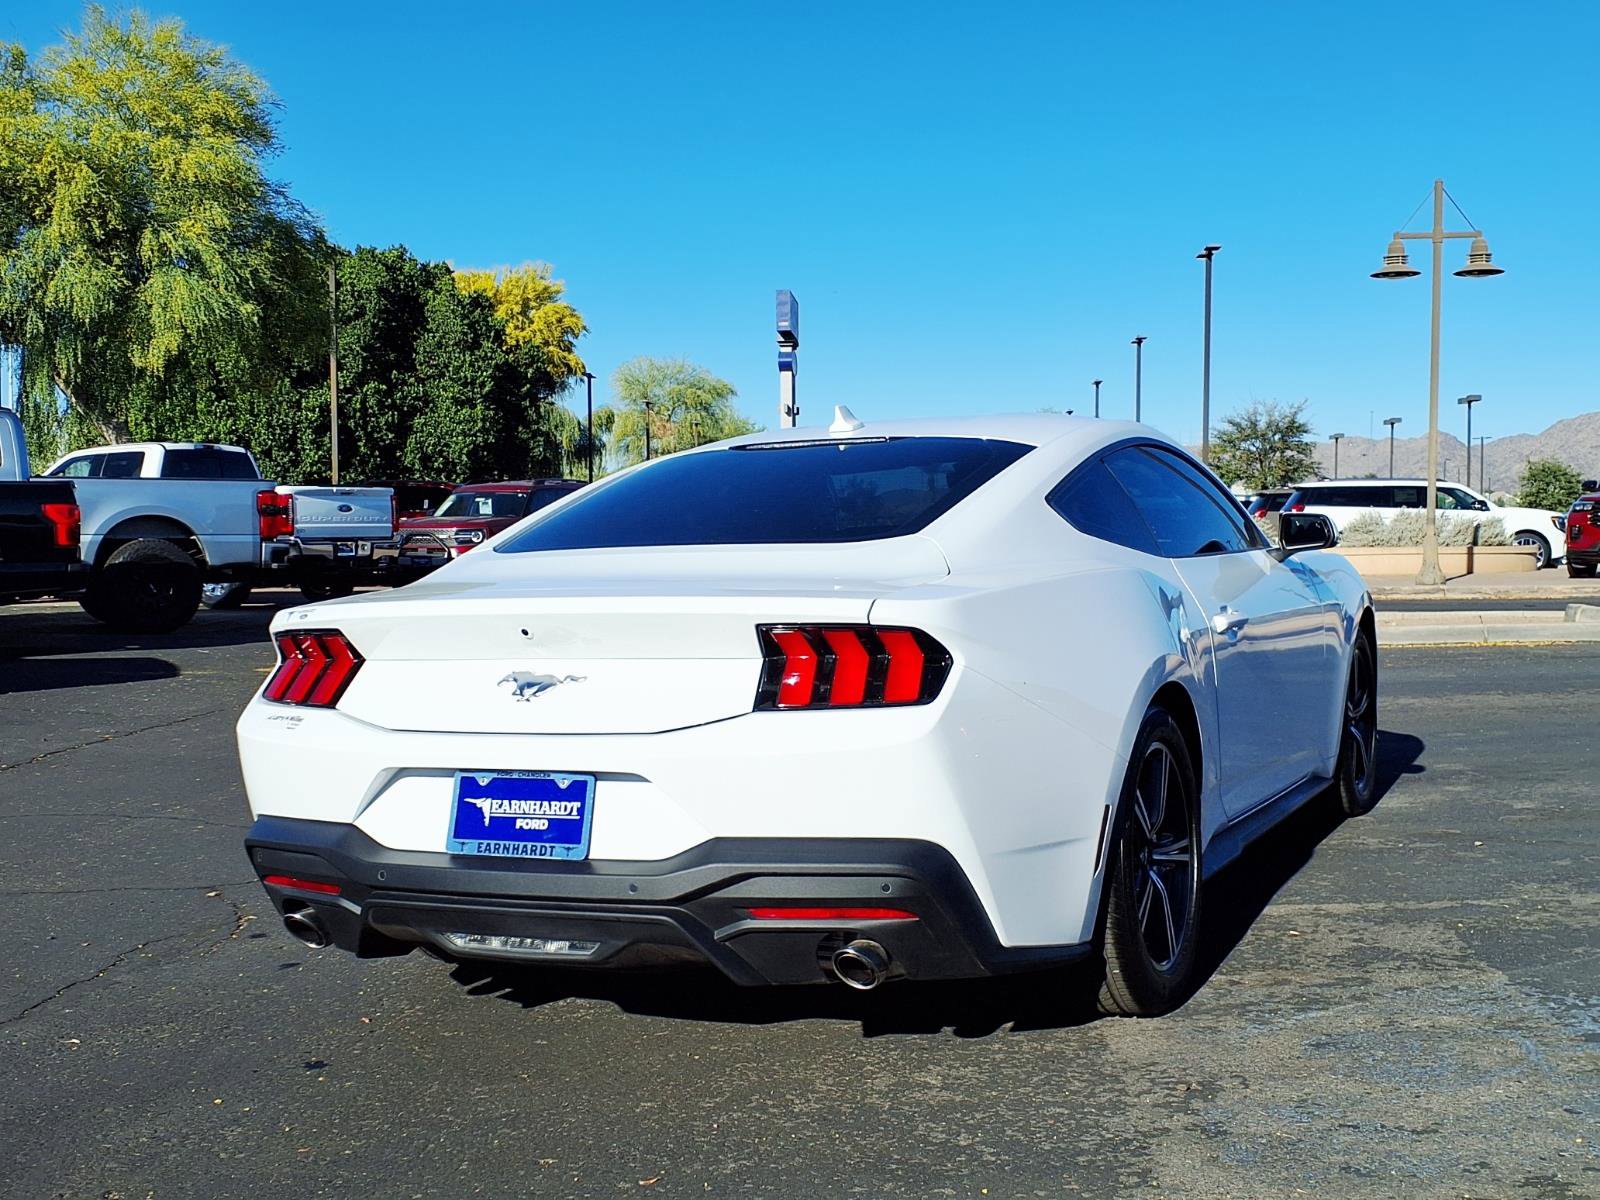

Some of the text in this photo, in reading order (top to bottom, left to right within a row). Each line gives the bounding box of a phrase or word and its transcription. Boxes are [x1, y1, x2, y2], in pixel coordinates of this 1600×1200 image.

[491, 799, 581, 816] EARNHARDT
[515, 818, 549, 830] FORD
[476, 842, 556, 857] EARNHARDT
